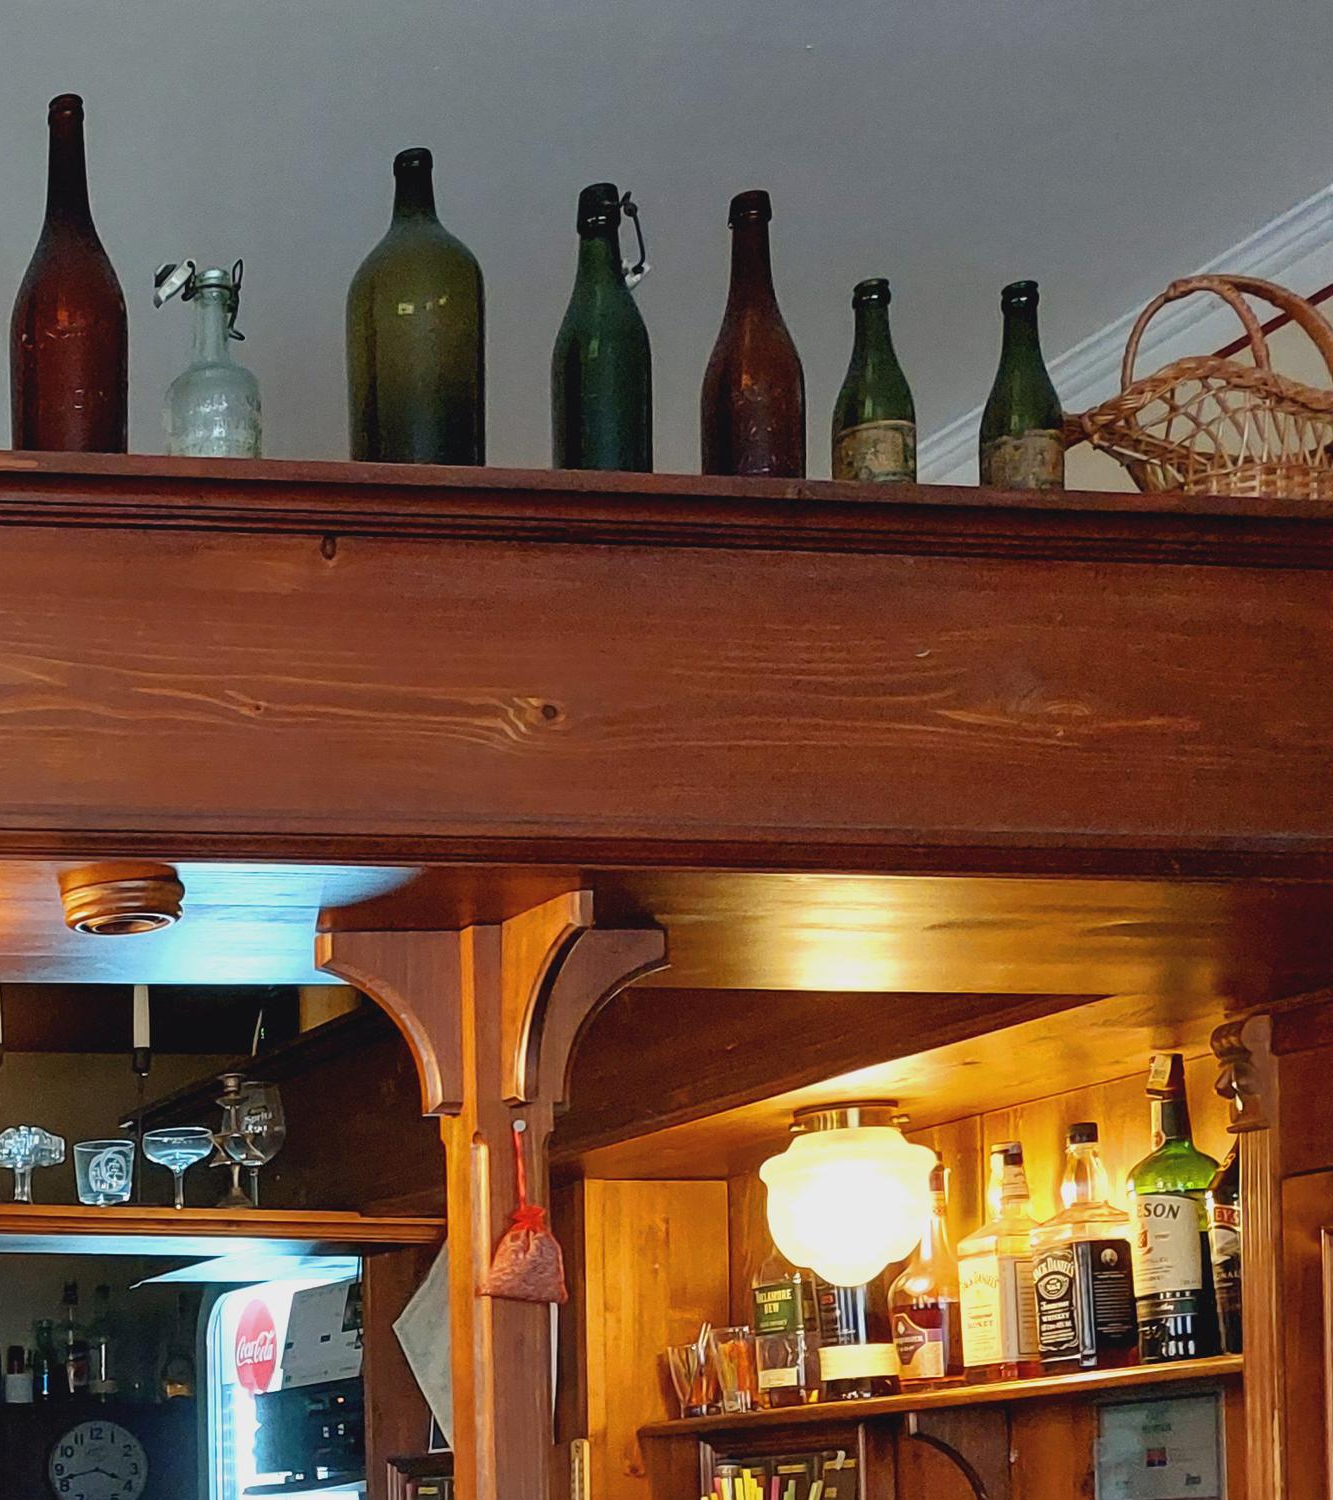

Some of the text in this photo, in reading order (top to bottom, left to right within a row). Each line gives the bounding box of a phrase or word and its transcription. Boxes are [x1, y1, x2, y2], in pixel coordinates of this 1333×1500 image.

[74, 1432, 84, 1446] 11
[90, 1428, 103, 1440] 12
[111, 1431, 115, 1444] 1
[60, 1446, 74, 1458] 10
[123, 1444, 132, 1457] 2
[55, 1463, 64, 1476] 9
[130, 1463, 138, 1475] 3
[60, 1480, 69, 1492] 8
[123, 1480, 133, 1492] 4
